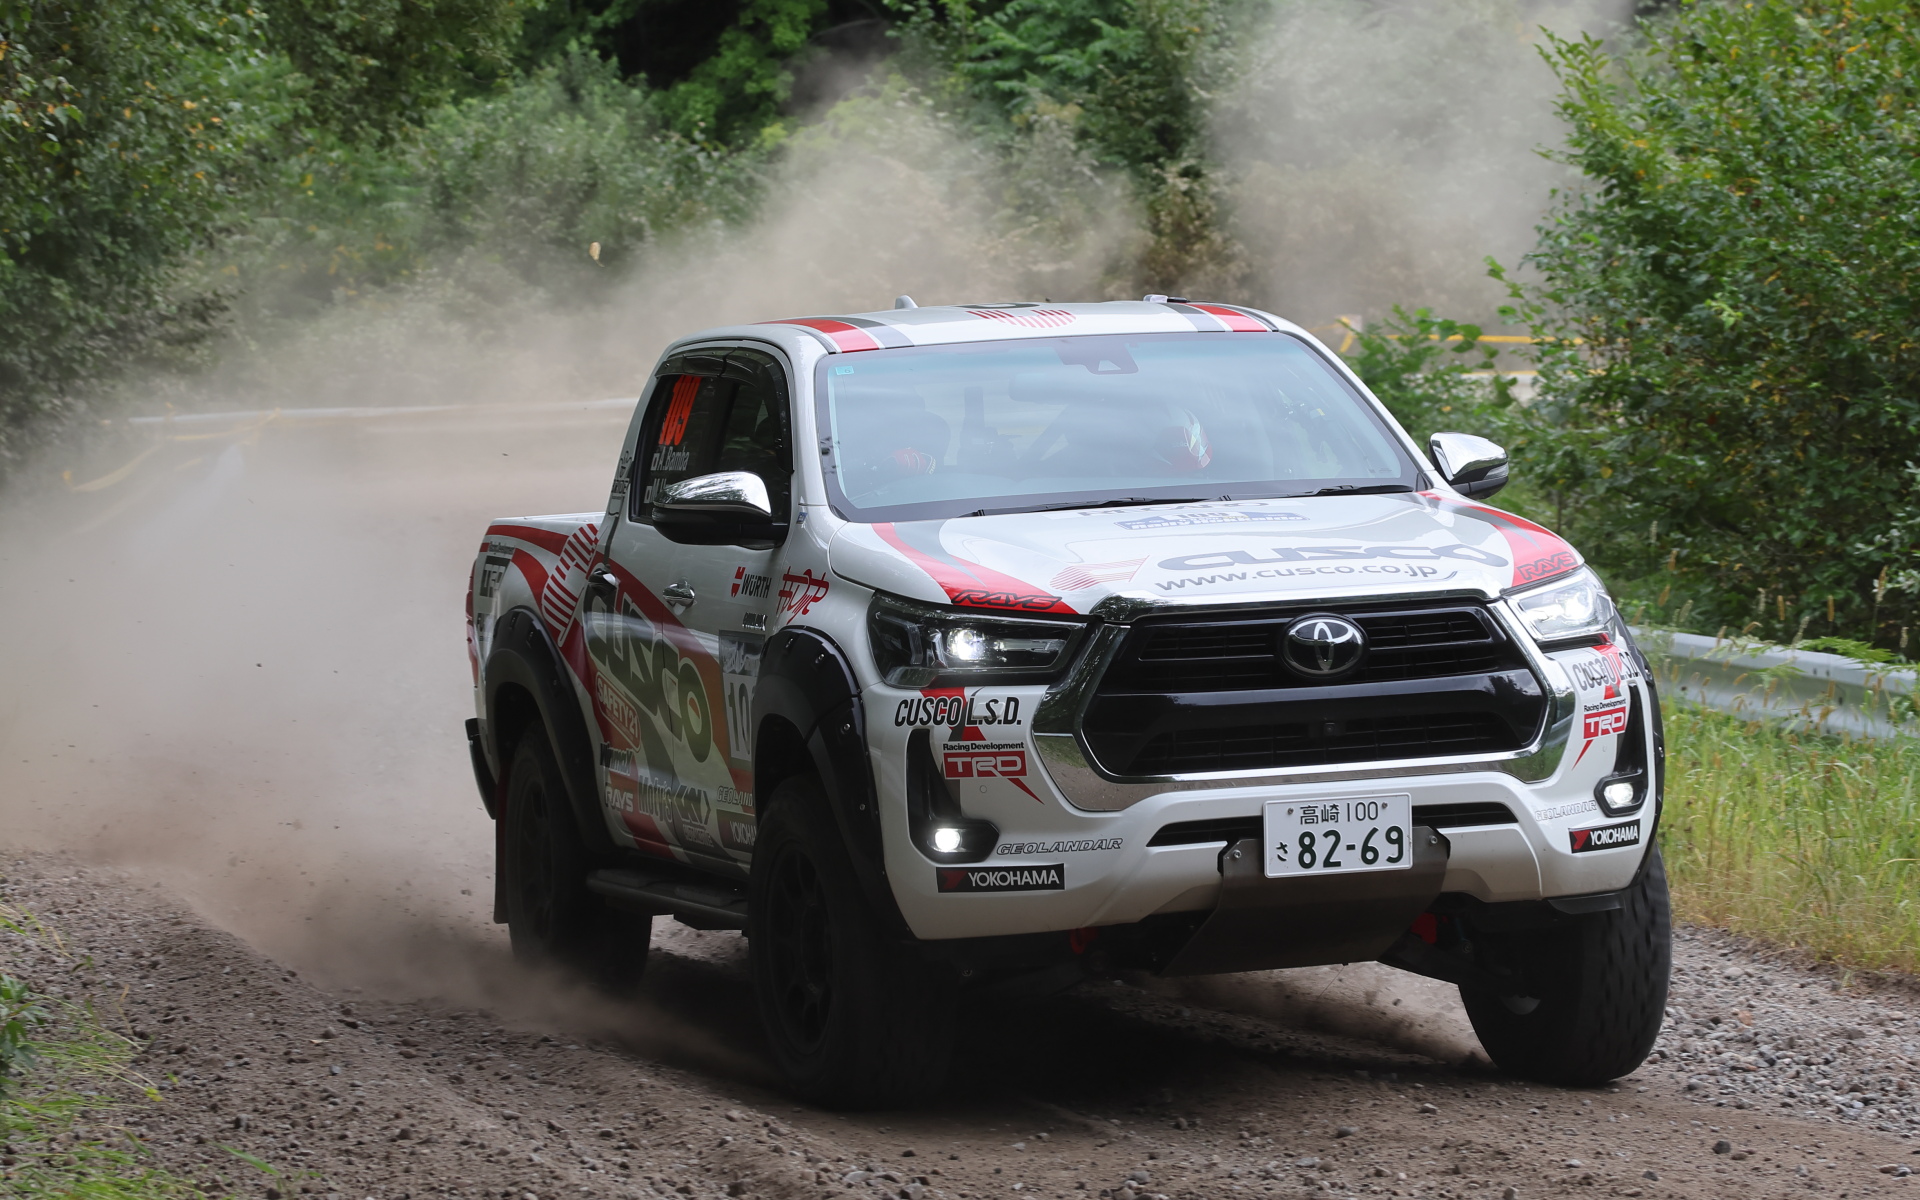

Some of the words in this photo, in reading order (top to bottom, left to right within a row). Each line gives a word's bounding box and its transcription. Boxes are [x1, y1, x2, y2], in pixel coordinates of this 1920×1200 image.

[1155, 563, 1438, 590] www.cusco.co.jp
[1517, 551, 1577, 580] RAYS
[741, 573, 772, 599] WÜRTH
[951, 589, 1062, 610] RAYS
[894, 696, 963, 727] CUSCO
[966, 695, 1022, 726] L.S.D.
[1584, 702, 1599, 712] Racing
[1600, 698, 1626, 710] Development
[1585, 712, 1625, 735] TRD
[943, 742, 970, 751] Racing
[971, 741, 1024, 751] Development
[947, 757, 1022, 777] TRD
[605, 787, 634, 812] RAYS
[638, 774, 673, 823] Moty's
[1300, 803, 1340, 825] 高崎
[1346, 801, 1379, 822] 100
[1535, 800, 1597, 821] GEOLANDAR
[996, 838, 1123, 855] GEOLANDAR
[1276, 841, 1288, 862] さ
[1298, 825, 1404, 869] 82-69
[1590, 825, 1638, 846] YOKOHAMA
[967, 869, 1060, 887] YOKOHAMA
